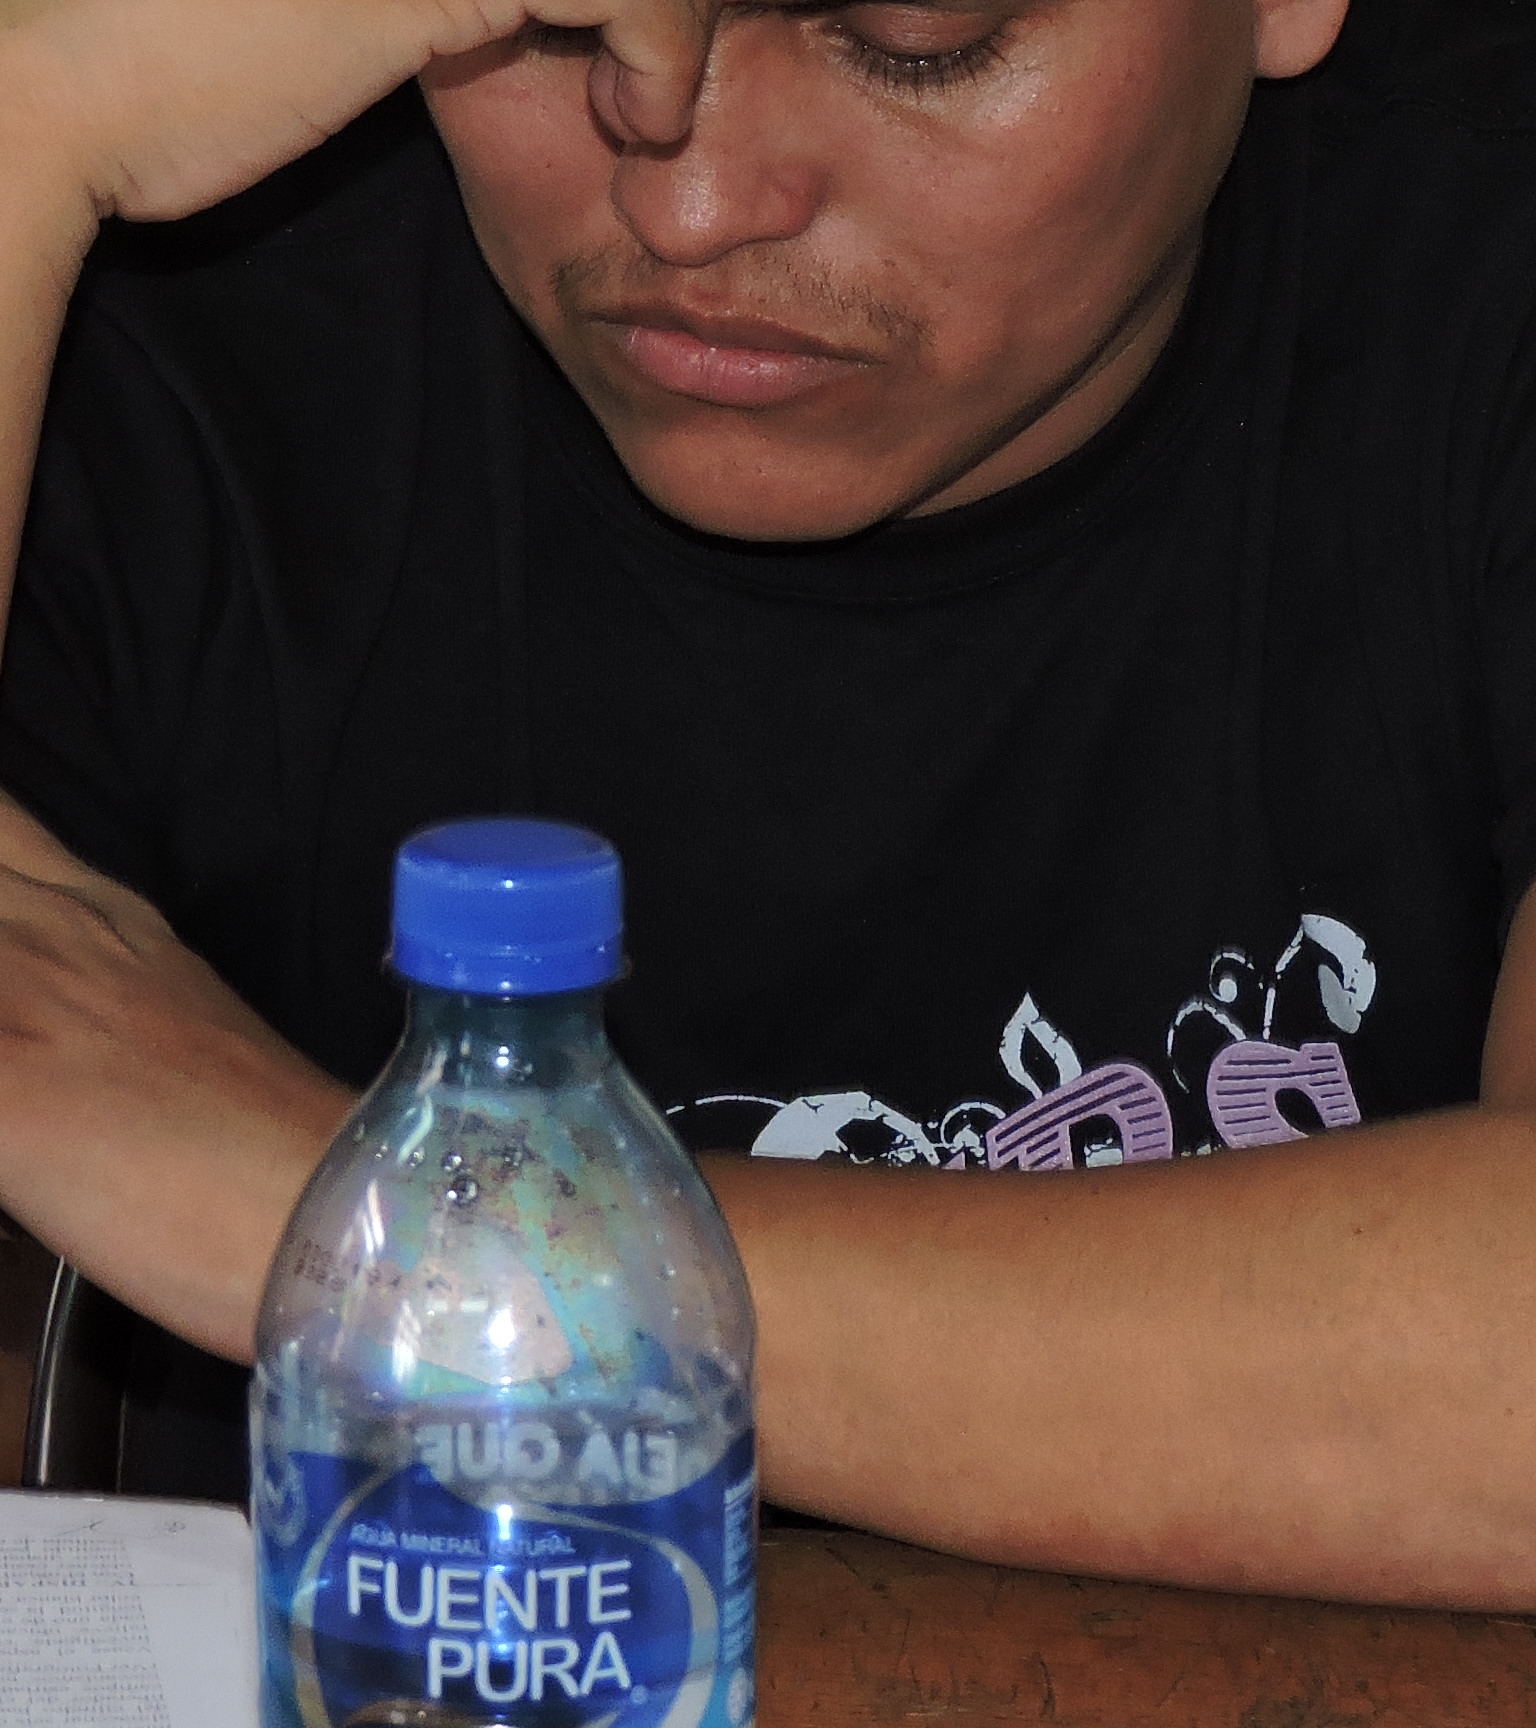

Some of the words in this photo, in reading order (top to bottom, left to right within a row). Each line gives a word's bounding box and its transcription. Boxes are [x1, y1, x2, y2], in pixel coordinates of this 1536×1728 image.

[400, 1531, 486, 1556] MINERAL
[347, 1555, 632, 1632] FUENTE
[427, 1630, 632, 1704] PURA
